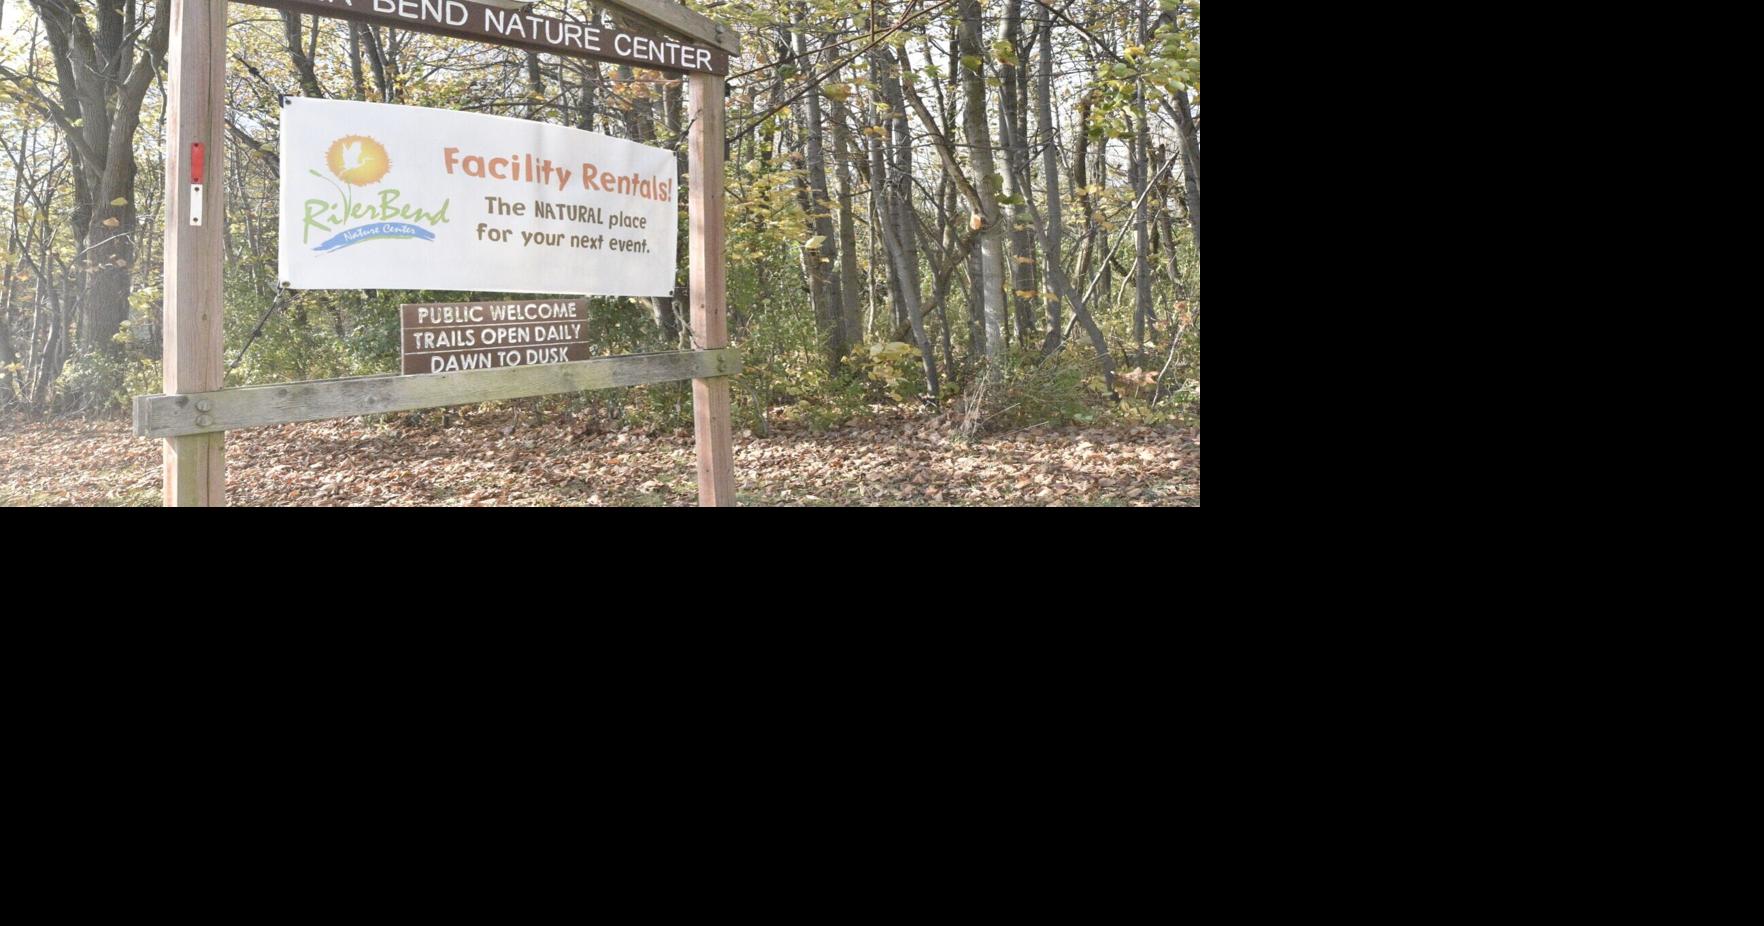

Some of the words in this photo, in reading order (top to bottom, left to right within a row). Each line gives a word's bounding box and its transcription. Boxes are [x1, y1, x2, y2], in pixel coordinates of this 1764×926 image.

[373, 0, 469, 26] BEND
[484, 7, 601, 51] NATURE
[613, 32, 713, 72] CENTER
[443, 146, 572, 192] Facility
[582, 162, 672, 203] Rentals!
[484, 196, 526, 216] The
[534, 200, 604, 225] NATURAL
[608, 210, 647, 230] place
[343, 225, 380, 241] Nature
[382, 223, 416, 235] Center
[476, 223, 513, 243] for
[520, 230, 565, 248] your
[570, 233, 604, 250] next
[609, 237, 651, 254] event.
[417, 306, 484, 324] PUBLIC
[490, 302, 577, 321] WELCOME
[413, 329, 476, 350] TRAILS
[480, 327, 530, 345] OPEN
[534, 323, 581, 342] DAILY
[430, 353, 492, 374] DAWN
[498, 350, 522, 367] TO
[526, 346, 569, 365] DUSK
